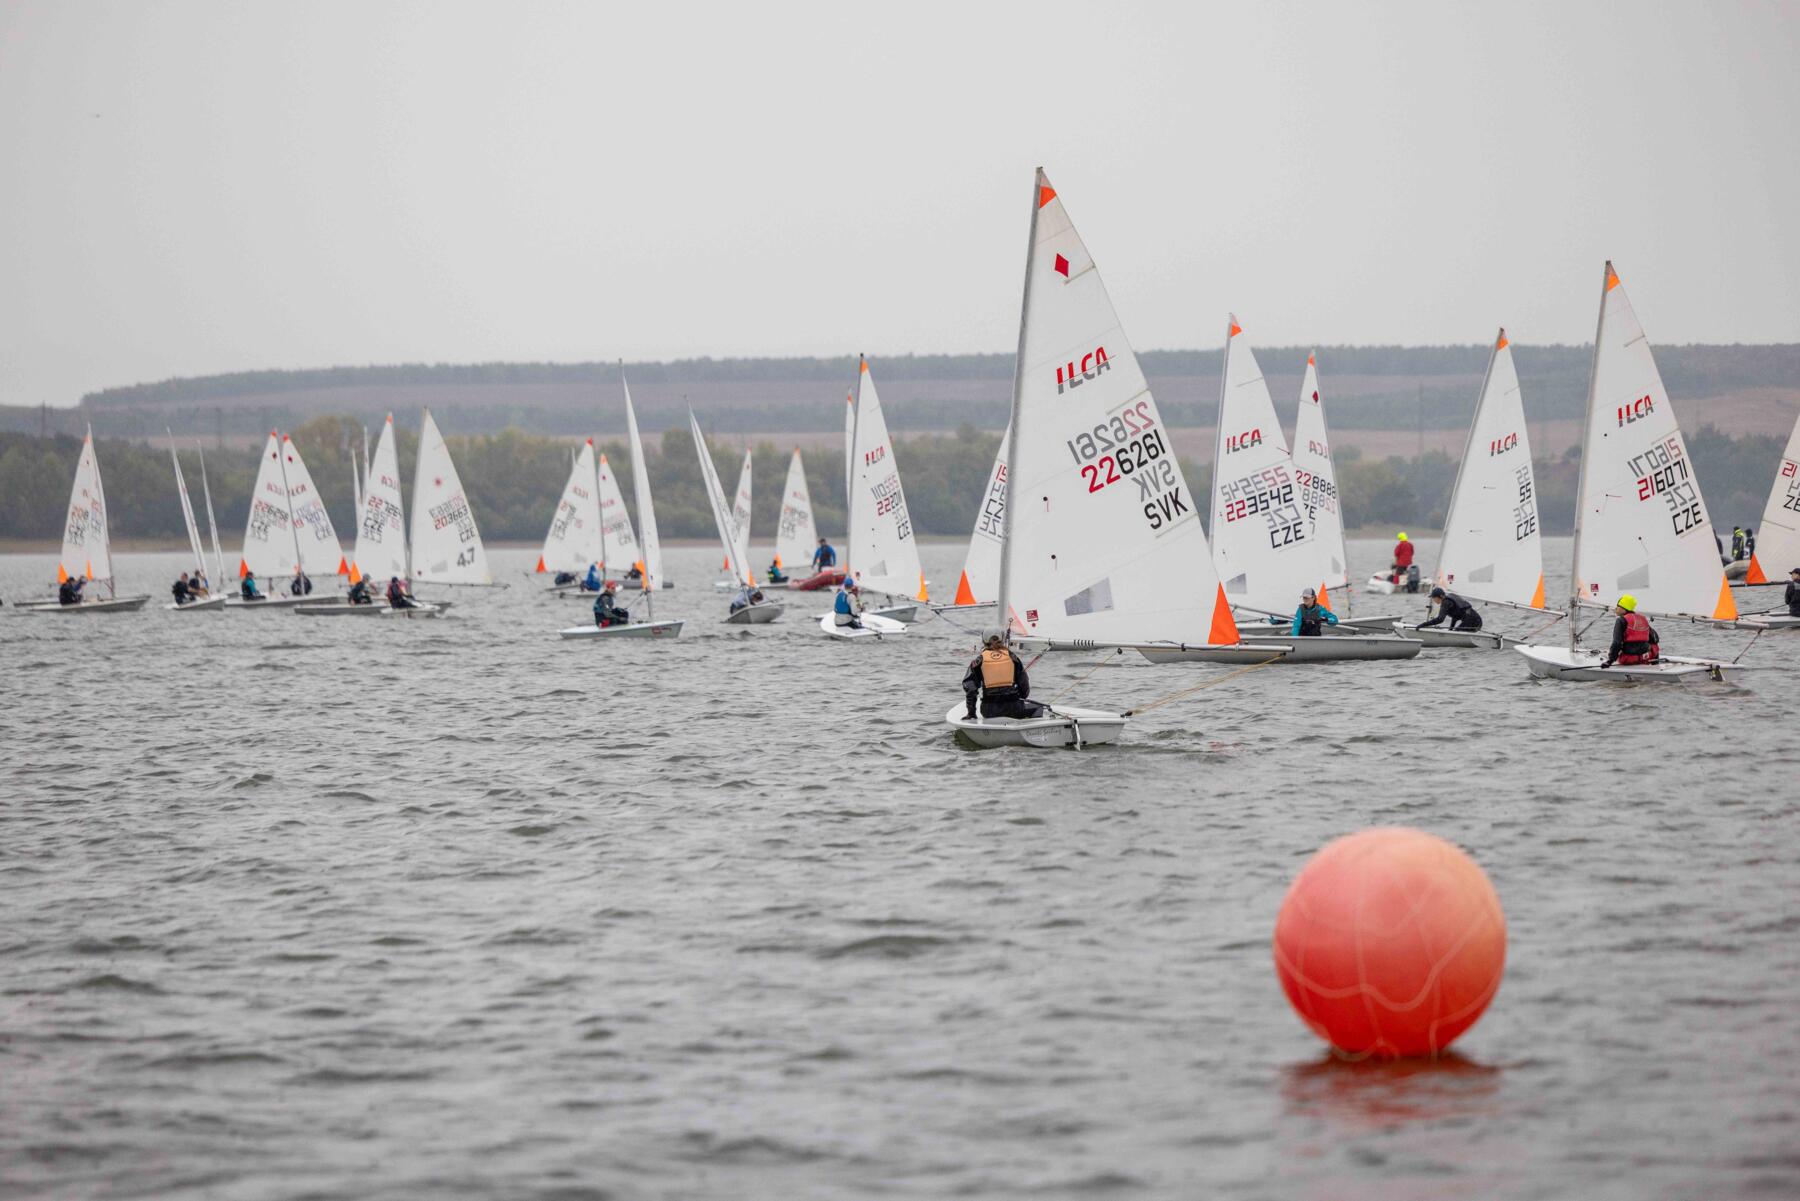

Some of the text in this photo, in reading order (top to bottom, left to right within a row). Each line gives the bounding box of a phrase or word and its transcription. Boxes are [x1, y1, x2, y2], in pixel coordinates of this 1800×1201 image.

[1056, 347, 1111, 394] ILCA
[1618, 395, 1654, 428] ILCA
[1226, 429, 1262, 454] ILCA
[1491, 432, 1518, 457] ILCA
[865, 446, 885, 467] ILCA
[1081, 429, 1165, 494] 226261
[1519, 481, 1532, 503] 55
[1637, 458, 1688, 501] 216071
[986, 499, 1005, 520] CZ
[1144, 487, 1188, 530] SVK
[1226, 484, 1294, 522] 223542
[898, 520, 910, 540] CZE
[1516, 516, 1536, 541] CZE
[1672, 502, 1703, 536] CZE
[459, 527, 475, 543] CZE
[1270, 522, 1304, 549] CZE
[457, 546, 475, 567] 4.7
